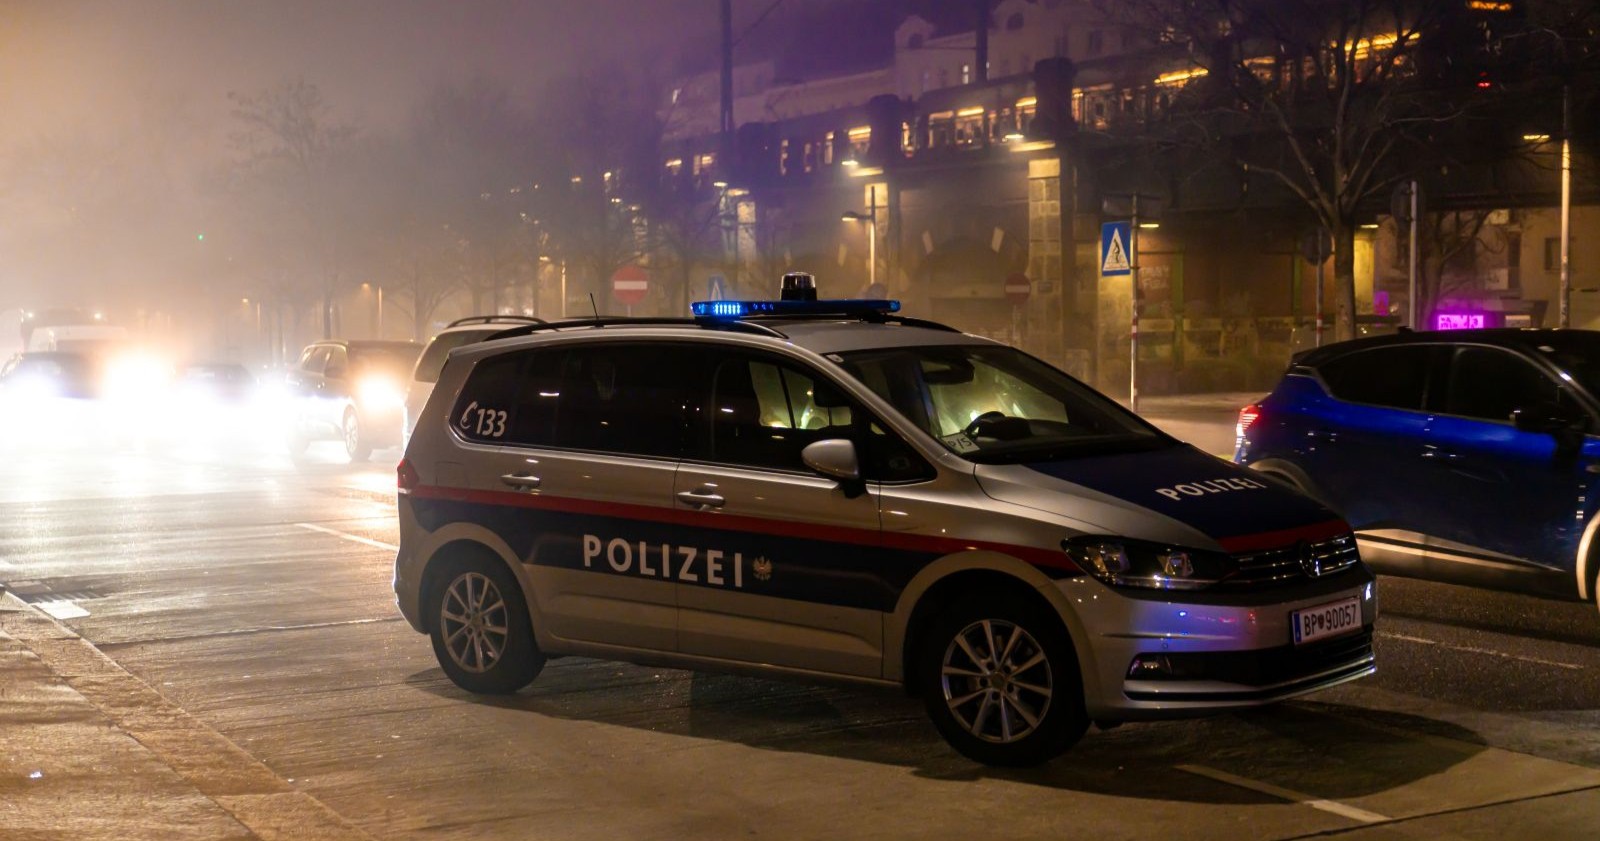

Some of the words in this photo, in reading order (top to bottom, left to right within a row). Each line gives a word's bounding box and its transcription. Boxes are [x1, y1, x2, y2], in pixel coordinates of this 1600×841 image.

[476, 408, 508, 437] 133
[1155, 478, 1267, 501] POLIZEI
[583, 534, 743, 588] POLIZEI
